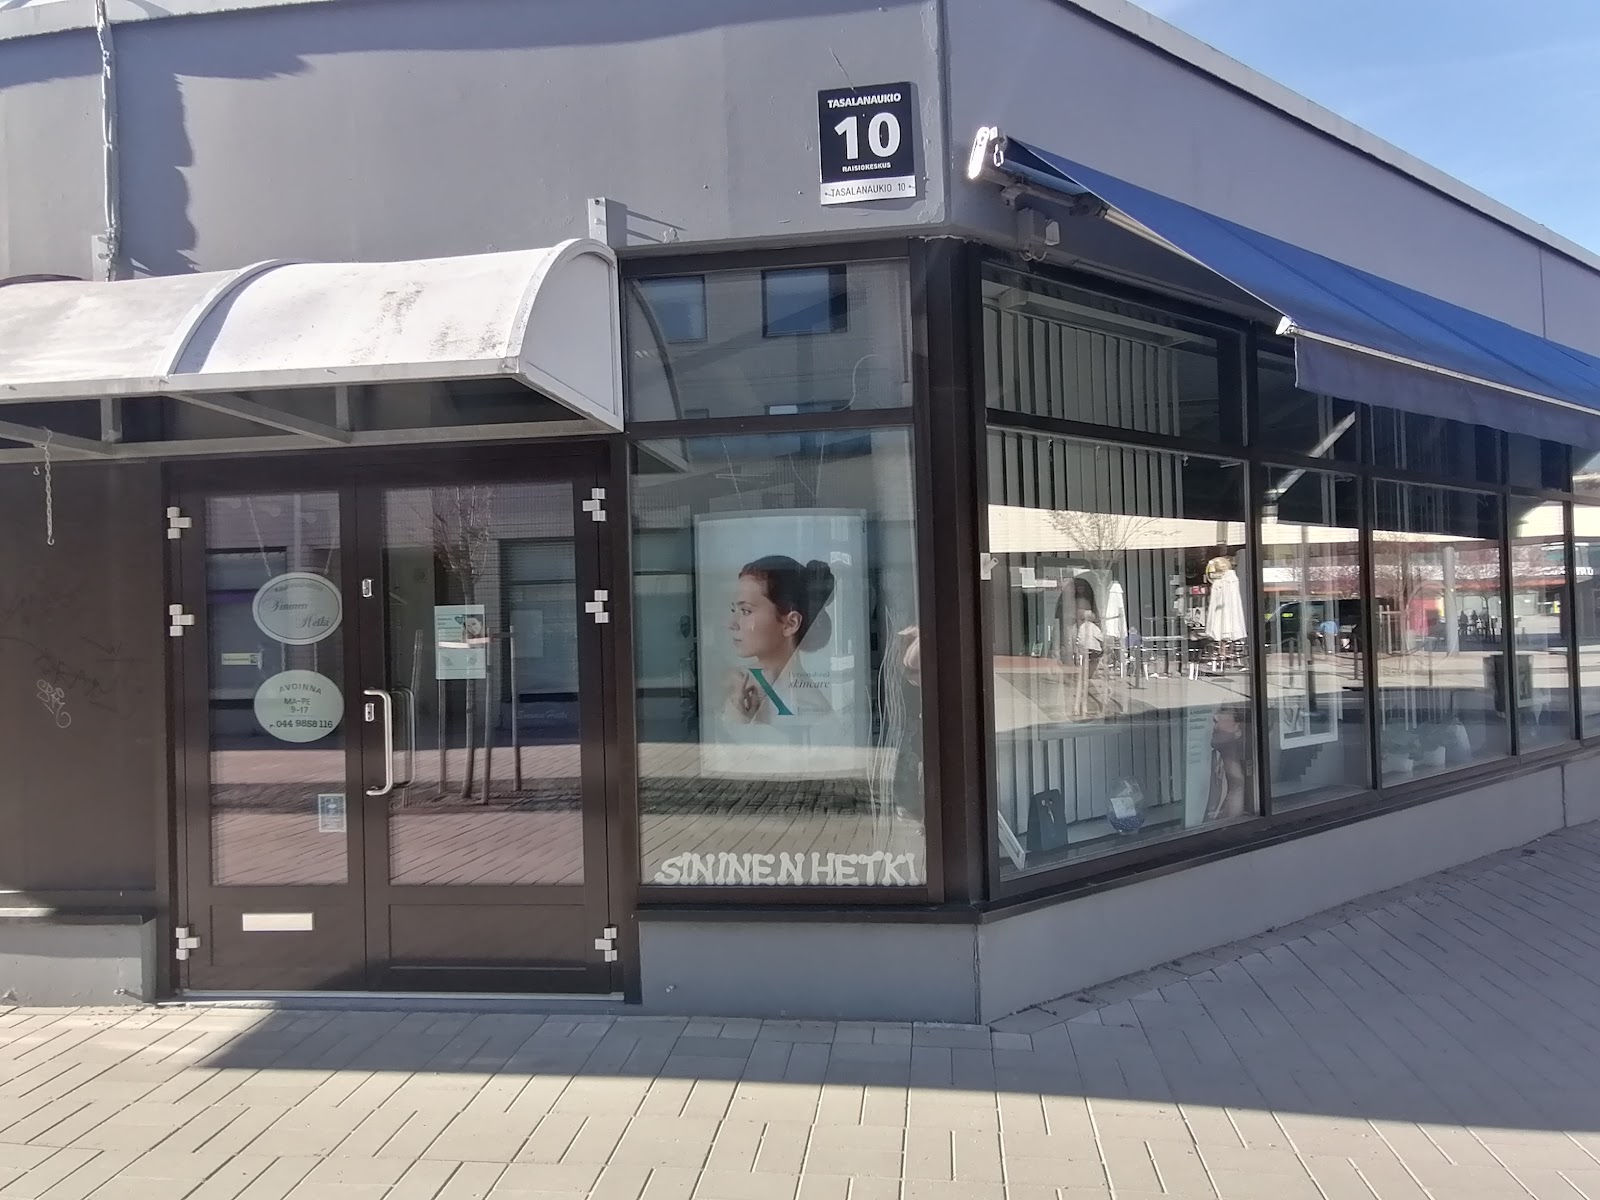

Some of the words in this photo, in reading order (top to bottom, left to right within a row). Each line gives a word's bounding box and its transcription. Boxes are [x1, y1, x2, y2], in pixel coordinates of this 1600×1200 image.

[828, 93, 901, 108] TASALANAUKIO
[834, 112, 901, 160] 10
[842, 162, 891, 172] RAISIOKESKUS
[831, 184, 892, 197] TASALANAUKIO
[897, 182, 906, 192] 10
[279, 683, 322, 695] AVOINNA
[788, 679, 831, 689] skincare
[284, 697, 311, 706] MA-PE
[290, 705, 309, 714] 9-17
[276, 719, 294, 729] 044
[319, 719, 334, 729] 116
[654, 851, 805, 886] SININEN
[811, 851, 919, 886] HETKI
